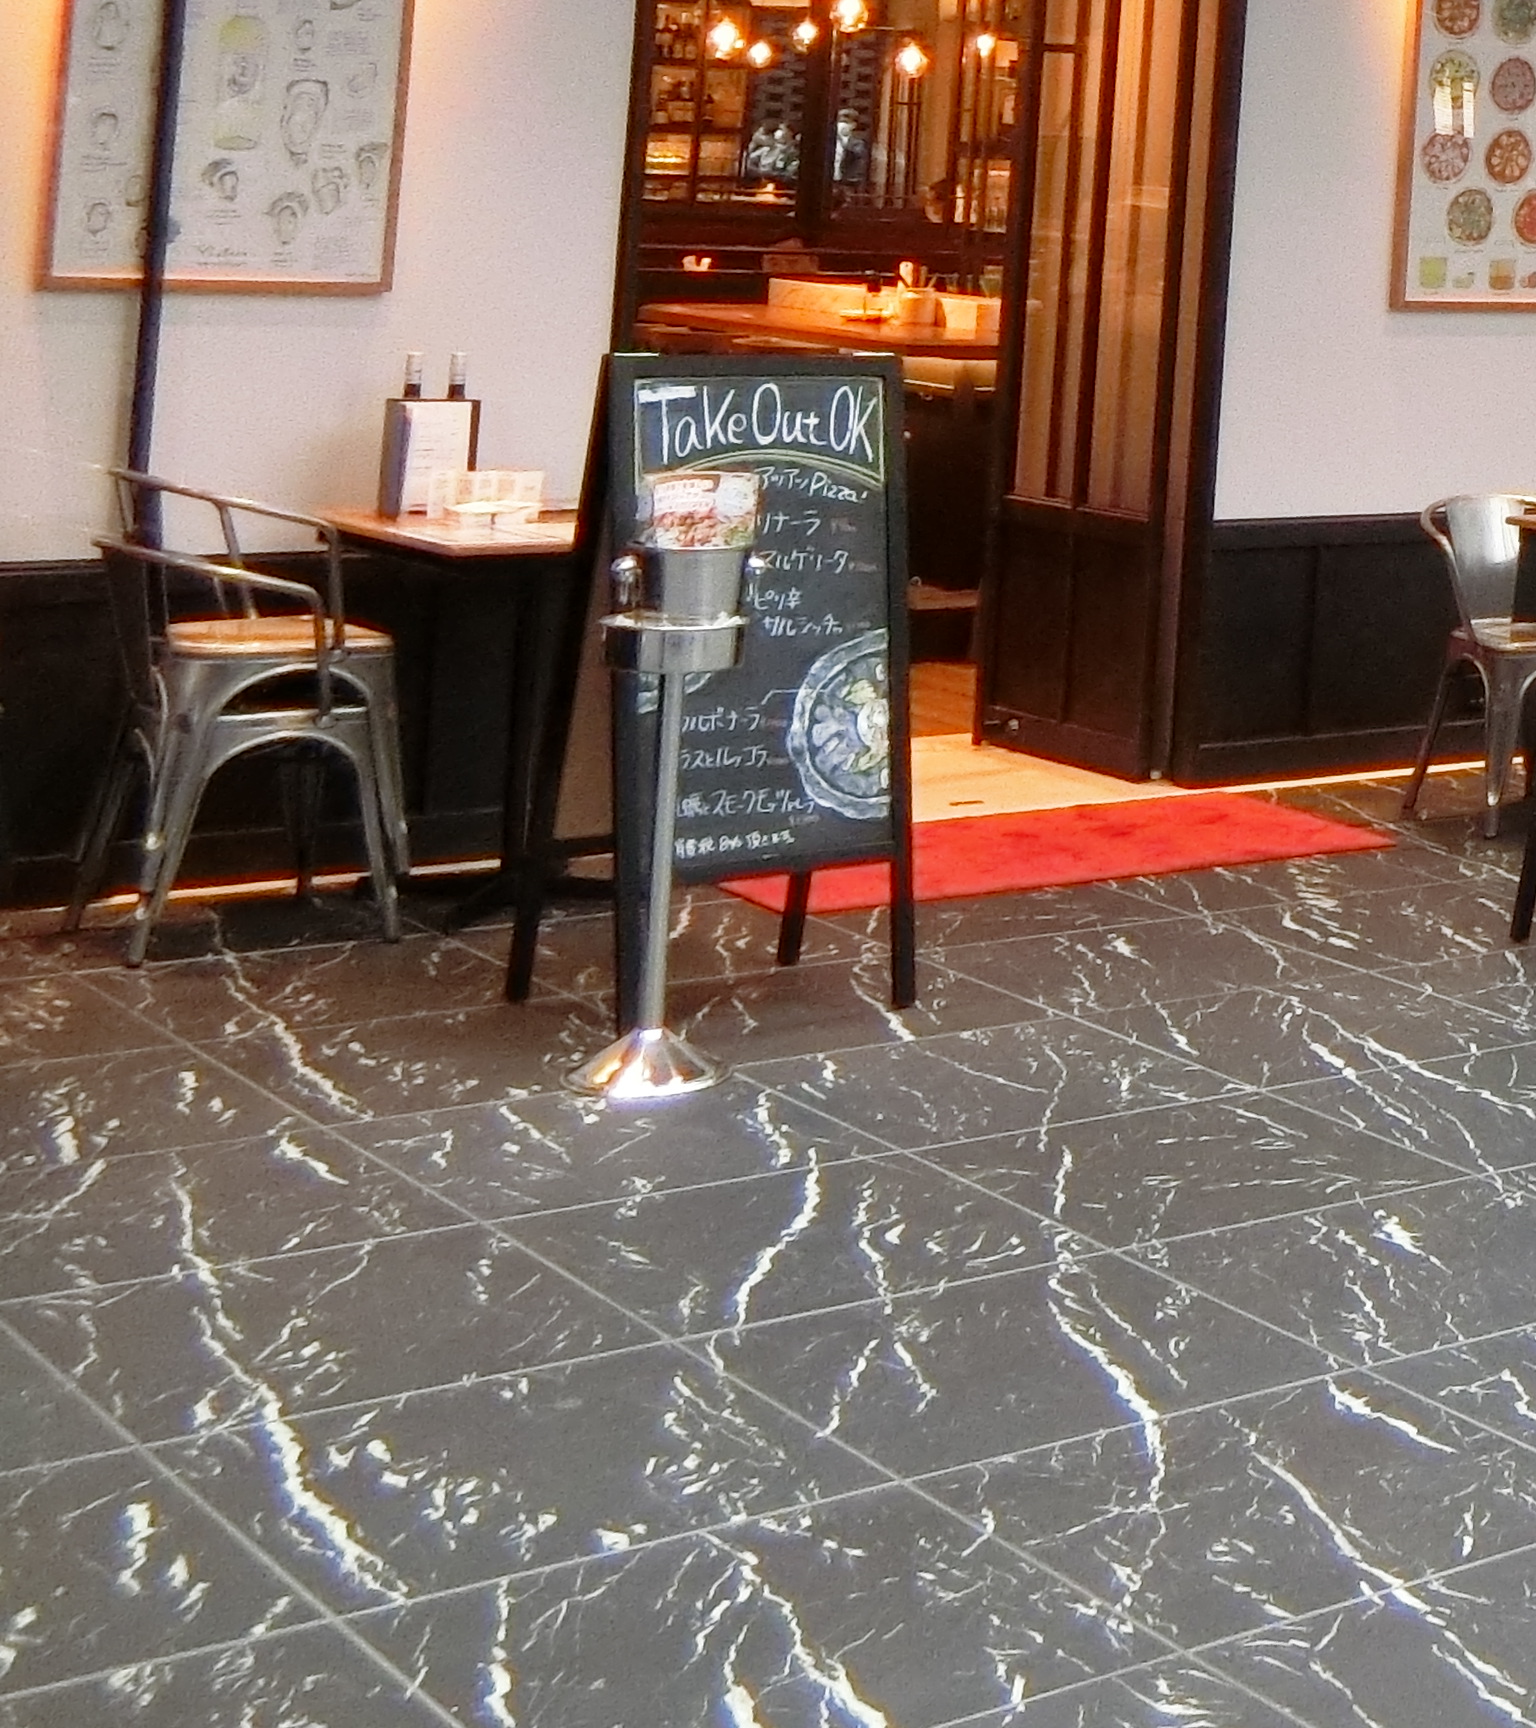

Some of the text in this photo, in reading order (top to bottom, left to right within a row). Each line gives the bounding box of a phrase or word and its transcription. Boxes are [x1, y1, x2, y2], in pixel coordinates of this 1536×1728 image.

[638, 383, 878, 464] Take Out OK
